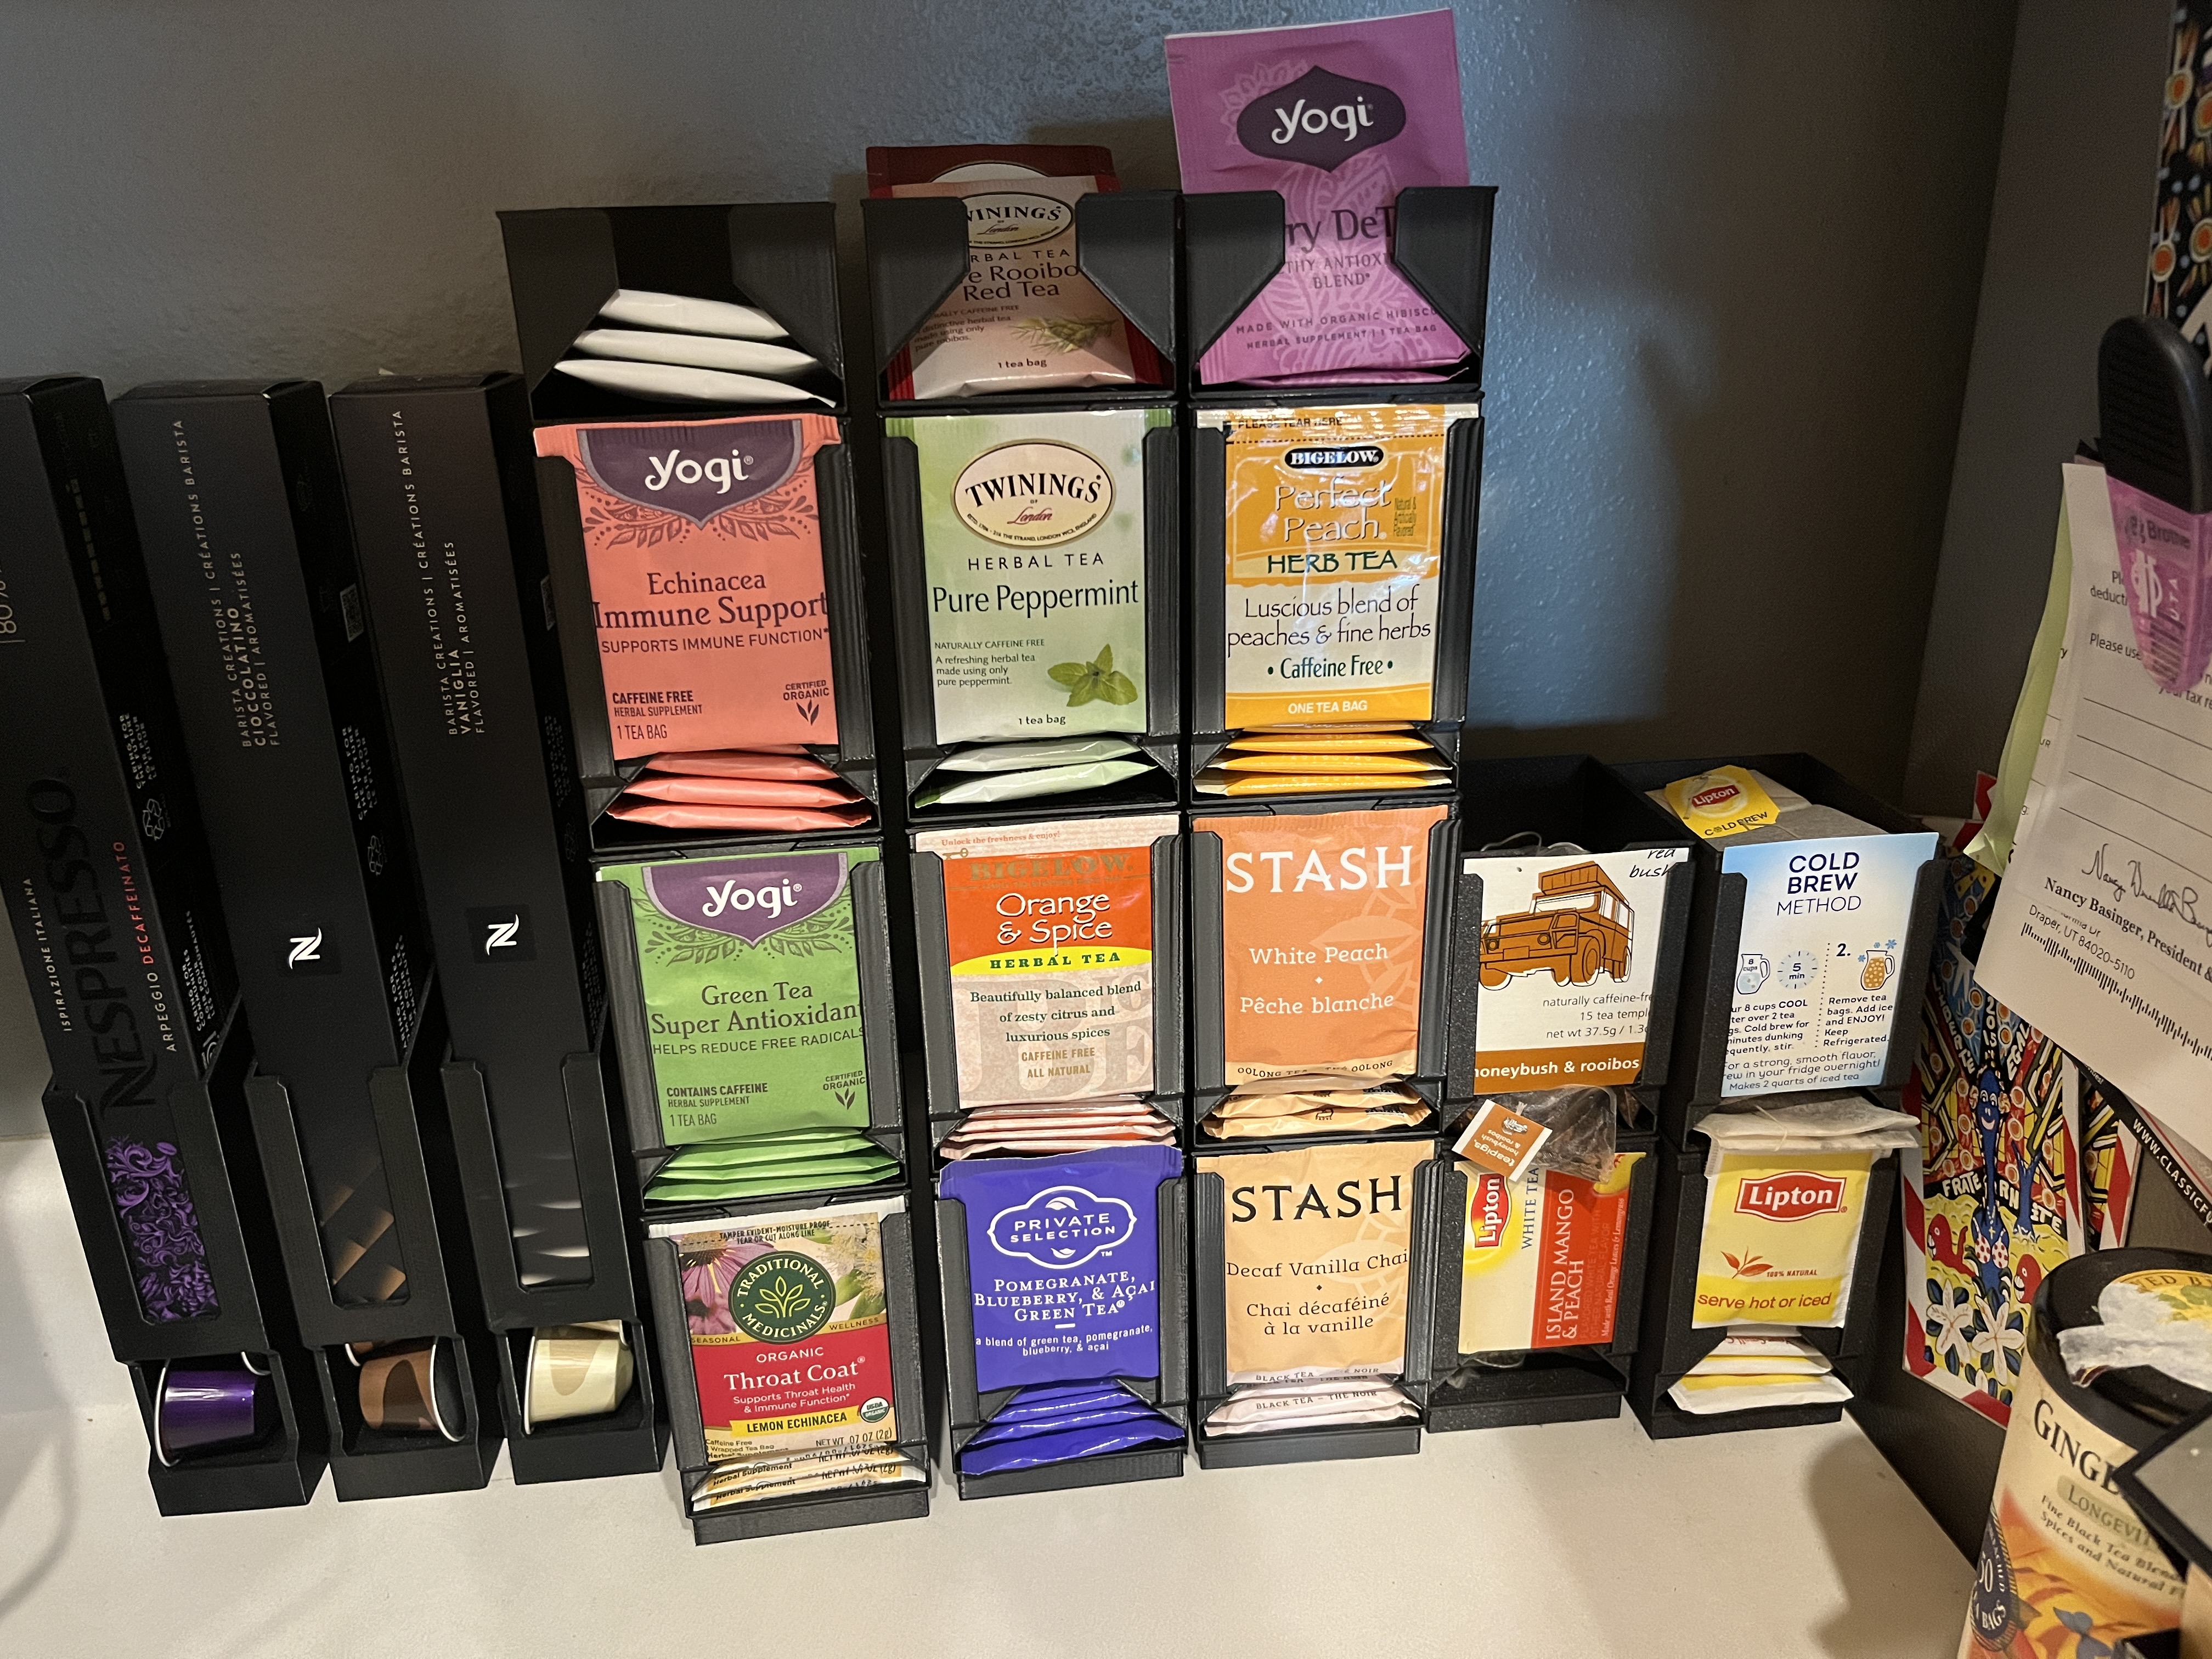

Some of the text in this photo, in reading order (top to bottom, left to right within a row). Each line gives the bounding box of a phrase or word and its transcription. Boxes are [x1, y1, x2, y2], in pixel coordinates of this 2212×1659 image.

[1272, 96, 1374, 144] yogi
[1032, 250, 1069, 258] TEA
[990, 263, 1079, 281] Rooibo
[963, 282, 1059, 301] Red Tea
[1237, 312, 1380, 334] MADE WITH ORGANIC
[1026, 358, 1047, 368] bag
[645, 449, 749, 494] yogi
[965, 473, 1102, 507] TWININGS
[1007, 507, 1052, 524] London
[968, 553, 1104, 571] HERBAL TEA
[1267, 551, 1398, 574] HERB TEA
[647, 571, 766, 596] Echinacea
[933, 579, 1139, 618] Pure Peppermint
[1245, 584, 1420, 618] Luscious blend of
[594, 593, 828, 629] Immune Support
[602, 640, 678, 653] SUPPORTS
[683, 635, 744, 650] IMMUNE
[935, 641, 983, 650] NATURALLY
[985, 640, 1024, 648] CAFFEINE
[1228, 613, 1431, 657] peaches & fine herbs
[2090, 633, 2122, 654] Please
[945, 654, 989, 664] refreshing
[991, 653, 1019, 663] herbal
[1280, 655, 1383, 678] Caffeine Free
[213, 599, 252, 747] BARISTA CREATIONS
[228, 607, 266, 747] CIOCCOLATINO
[448, 649, 472, 733] VANIGLIA
[613, 691, 693, 704] CAFFEINE FREE
[257, 673, 280, 745] FLAVORED
[1288, 700, 1367, 714] ONE TEA BAG
[1694, 786, 1735, 805] Lipton
[1226, 845, 1412, 893] STASH
[1789, 852, 1859, 872] COLD
[1787, 873, 1857, 894] BREW
[702, 878, 798, 918] yogi
[996, 893, 1110, 923] Orange
[1777, 896, 1861, 915] METHOD
[2044, 877, 2087, 908] Nancy
[2089, 897, 2144, 941] Basinger,
[2147, 930, 2203, 975] President
[113, 842, 177, 1051] ARPEGGIO DECAFFEINATO
[997, 919, 1113, 956] & Spice
[2030, 905, 2062, 934] Draper,
[2064, 926, 2078, 945] UT
[2078, 935, 2135, 979] 84020-5110
[23, 879, 72, 1031] ISPIRAZIONE ITALIANA
[990, 952, 1121, 969] HERBAL TEA
[1249, 944, 1389, 964] White Peach
[702, 982, 813, 1005] Green Tea
[970, 981, 1141, 1004] Beautifully balanced blend
[1240, 992, 1394, 1014] Pêche blanche
[1543, 996, 1589, 1007] naturally
[1829, 996, 1867, 1005] Remove
[1000, 1006, 1116, 1024] of zesty citrus and
[1581, 1010, 1613, 1021] 15 tea
[652, 1014, 719, 1039] Super
[1006, 1028, 1110, 1042] luxurious spices
[1568, 1029, 1581, 1037] wt
[1585, 1027, 1616, 1037] 37.5g
[1825, 1028, 1848, 1039] Keep
[653, 1037, 797, 1054] HELPS REDUCE FREE
[1564, 1058, 1639, 1073] & rooibos
[1796, 1053, 1838, 1064] smooth
[1729, 1081, 1760, 1091] Makes
[1771, 1078, 1806, 1090] quarts
[1820, 1075, 1841, 1084] iced
[1844, 1073, 1859, 1081] tea
[1232, 1175, 1402, 1222] STASH
[1521, 1168, 1539, 1249] WHITE TEA
[1748, 1186, 1832, 1210] Lipton
[1014, 1212, 1110, 1231] PRIVATE
[1486, 1178, 1501, 1243] Lipton
[1011, 1226, 1115, 1243] SELECTION
[1226, 1249, 1408, 1278] Decaf Vanilla Chai
[1546, 1189, 1575, 1339] ISLAND MANGO
[737, 1258, 822, 1297] TRADITIONAL
[1092, 1287, 1104, 1300] &
[1247, 1292, 1390, 1317] Chai décaféiné
[1562, 1260, 1584, 1339] & PEACH
[1697, 1293, 1832, 1308] serve hot or iced
[743, 1305, 826, 1338] MEDICINALS
[1014, 1308, 1075, 1321] GREEN
[1264, 1316, 1374, 1335] à la vanille
[756, 1347, 823, 1363] ORGANIC
[724, 1370, 802, 1391] Throat
[733, 1383, 855, 1405] Supports Throat Health
[747, 1412, 847, 1434] LEMON ECHINACEA
[2067, 1485, 2153, 1550] LONGEVIT
